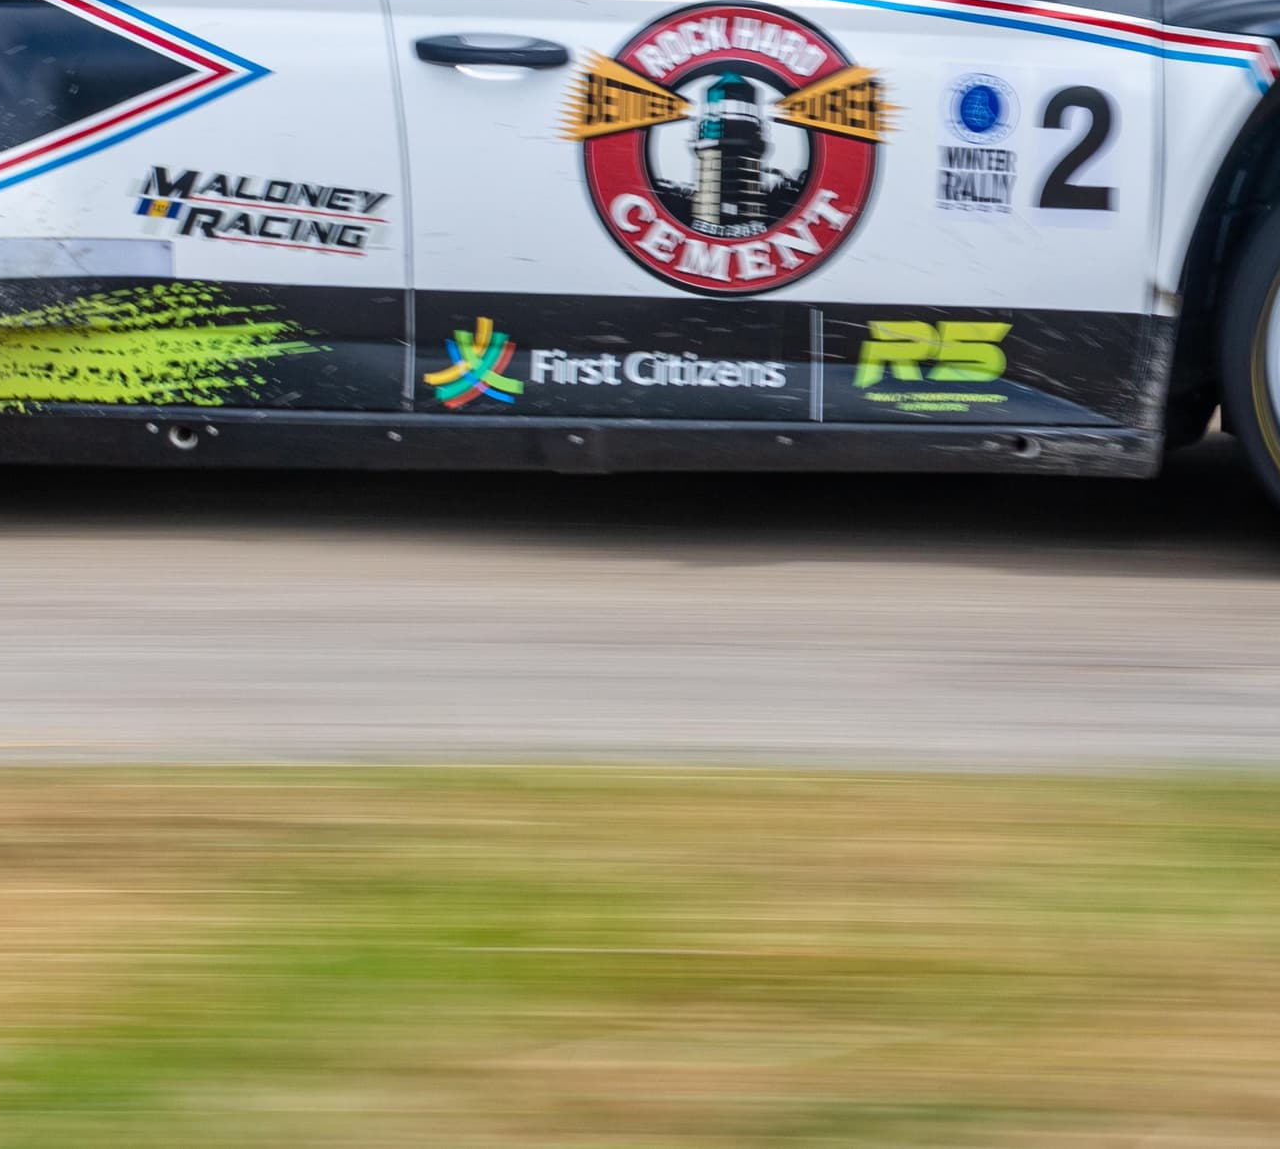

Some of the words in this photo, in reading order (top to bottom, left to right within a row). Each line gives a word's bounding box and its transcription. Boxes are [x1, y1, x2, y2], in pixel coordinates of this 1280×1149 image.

[634, 16, 730, 78] ROCK
[730, 16, 828, 77] HARD
[940, 146, 1018, 172] WINTER
[1035, 85, 1118, 211] 2
[144, 165, 392, 214] MALONEY
[937, 170, 1018, 205] RALLY
[178, 207, 370, 249] RACING
[609, 188, 853, 282] CEMENT
[530, 348, 622, 385] First
[623, 350, 788, 388] Citizens
[852, 320, 1014, 389] R5
